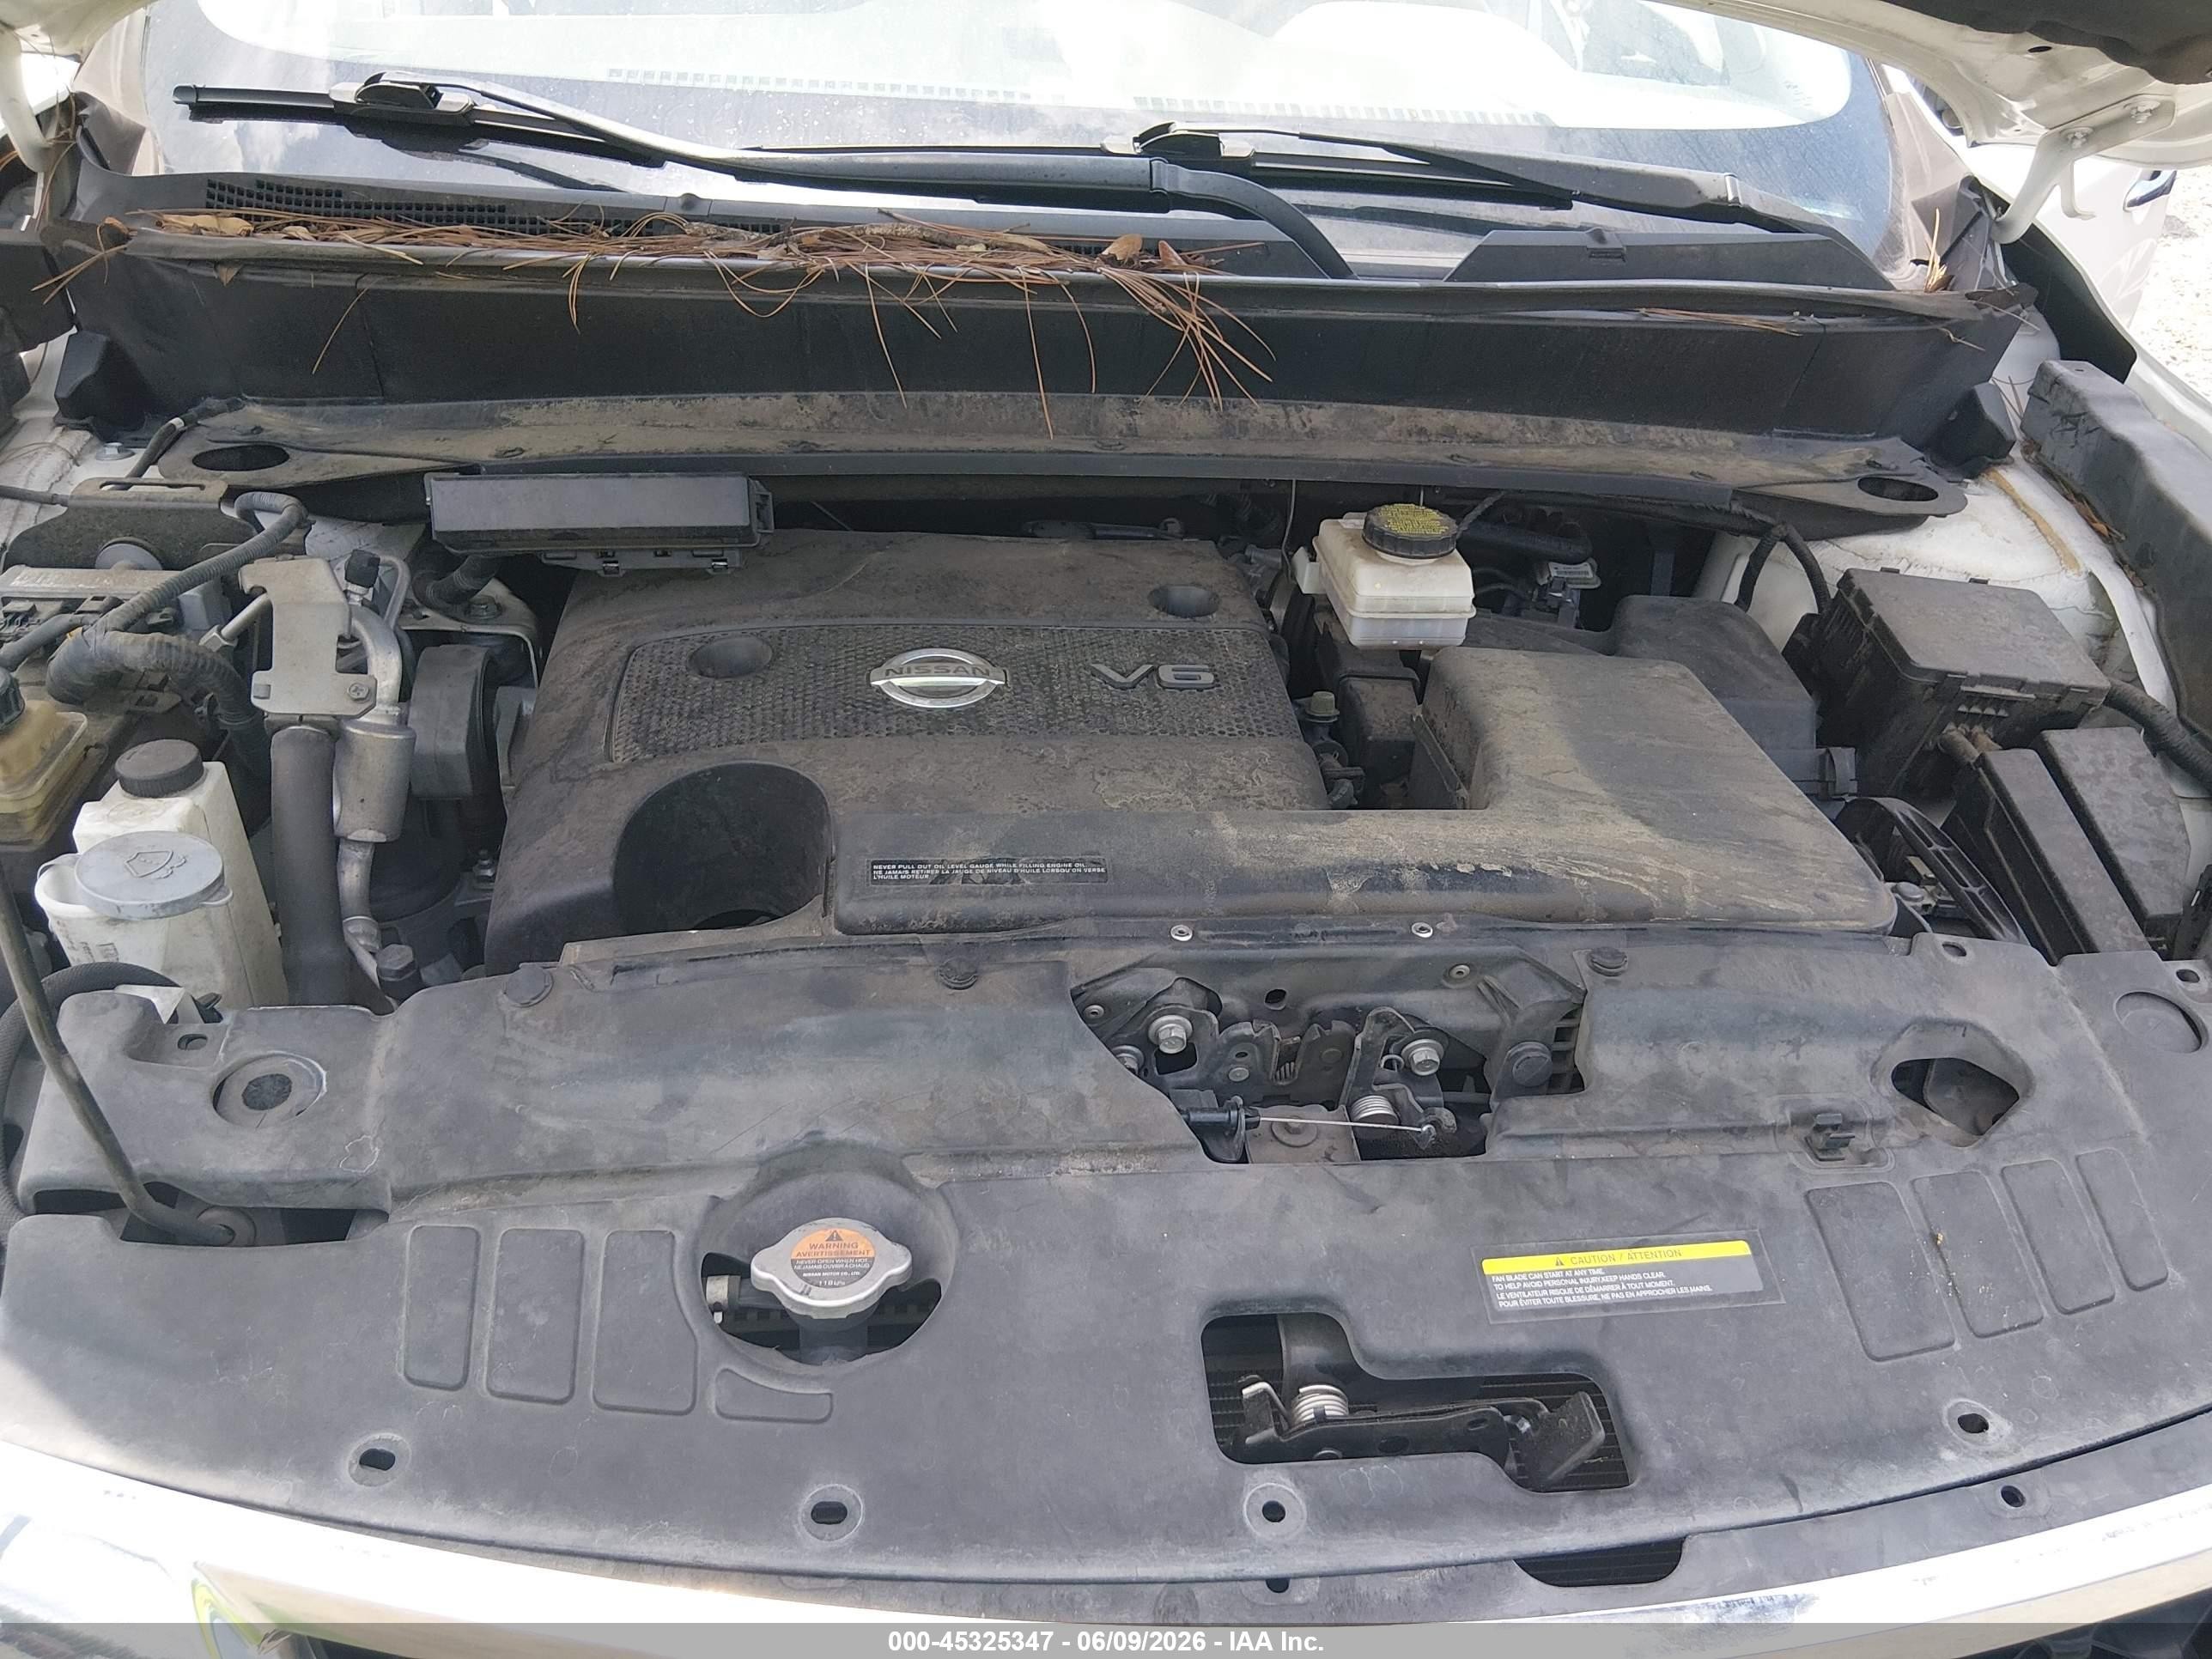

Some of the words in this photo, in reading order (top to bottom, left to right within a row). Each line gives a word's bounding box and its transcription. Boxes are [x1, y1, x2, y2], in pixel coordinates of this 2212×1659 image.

[884, 664, 990, 677] NISSAN
[1091, 664, 1216, 690] V6
[809, 1242, 859, 1250] WARNING
[1570, 1254, 1616, 1265] CAUTION
[1627, 1249, 1682, 1261] ATTENTION
[1544, 1279, 1579, 1287] PERSONAL
[1643, 1271, 1666, 1279] CLEAR.
[1574, 1268, 1588, 1277] ANY
[1589, 1267, 1606, 1276] TIME.
[1506, 1289, 1548, 1299] VENTILATEUR
[1549, 1287, 1573, 1296] RISQUE
[1586, 1284, 1620, 1294] DÉMARRER
[1627, 1280, 1644, 1289] TOUT
[1644, 1279, 1675, 1288] MOMENT.
[1519, 1297, 1542, 1306] ÉVITER
[1565, 1295, 1601, 1304] BLESSURE,
[1636, 1288, 1675, 1297] APPROCHER
